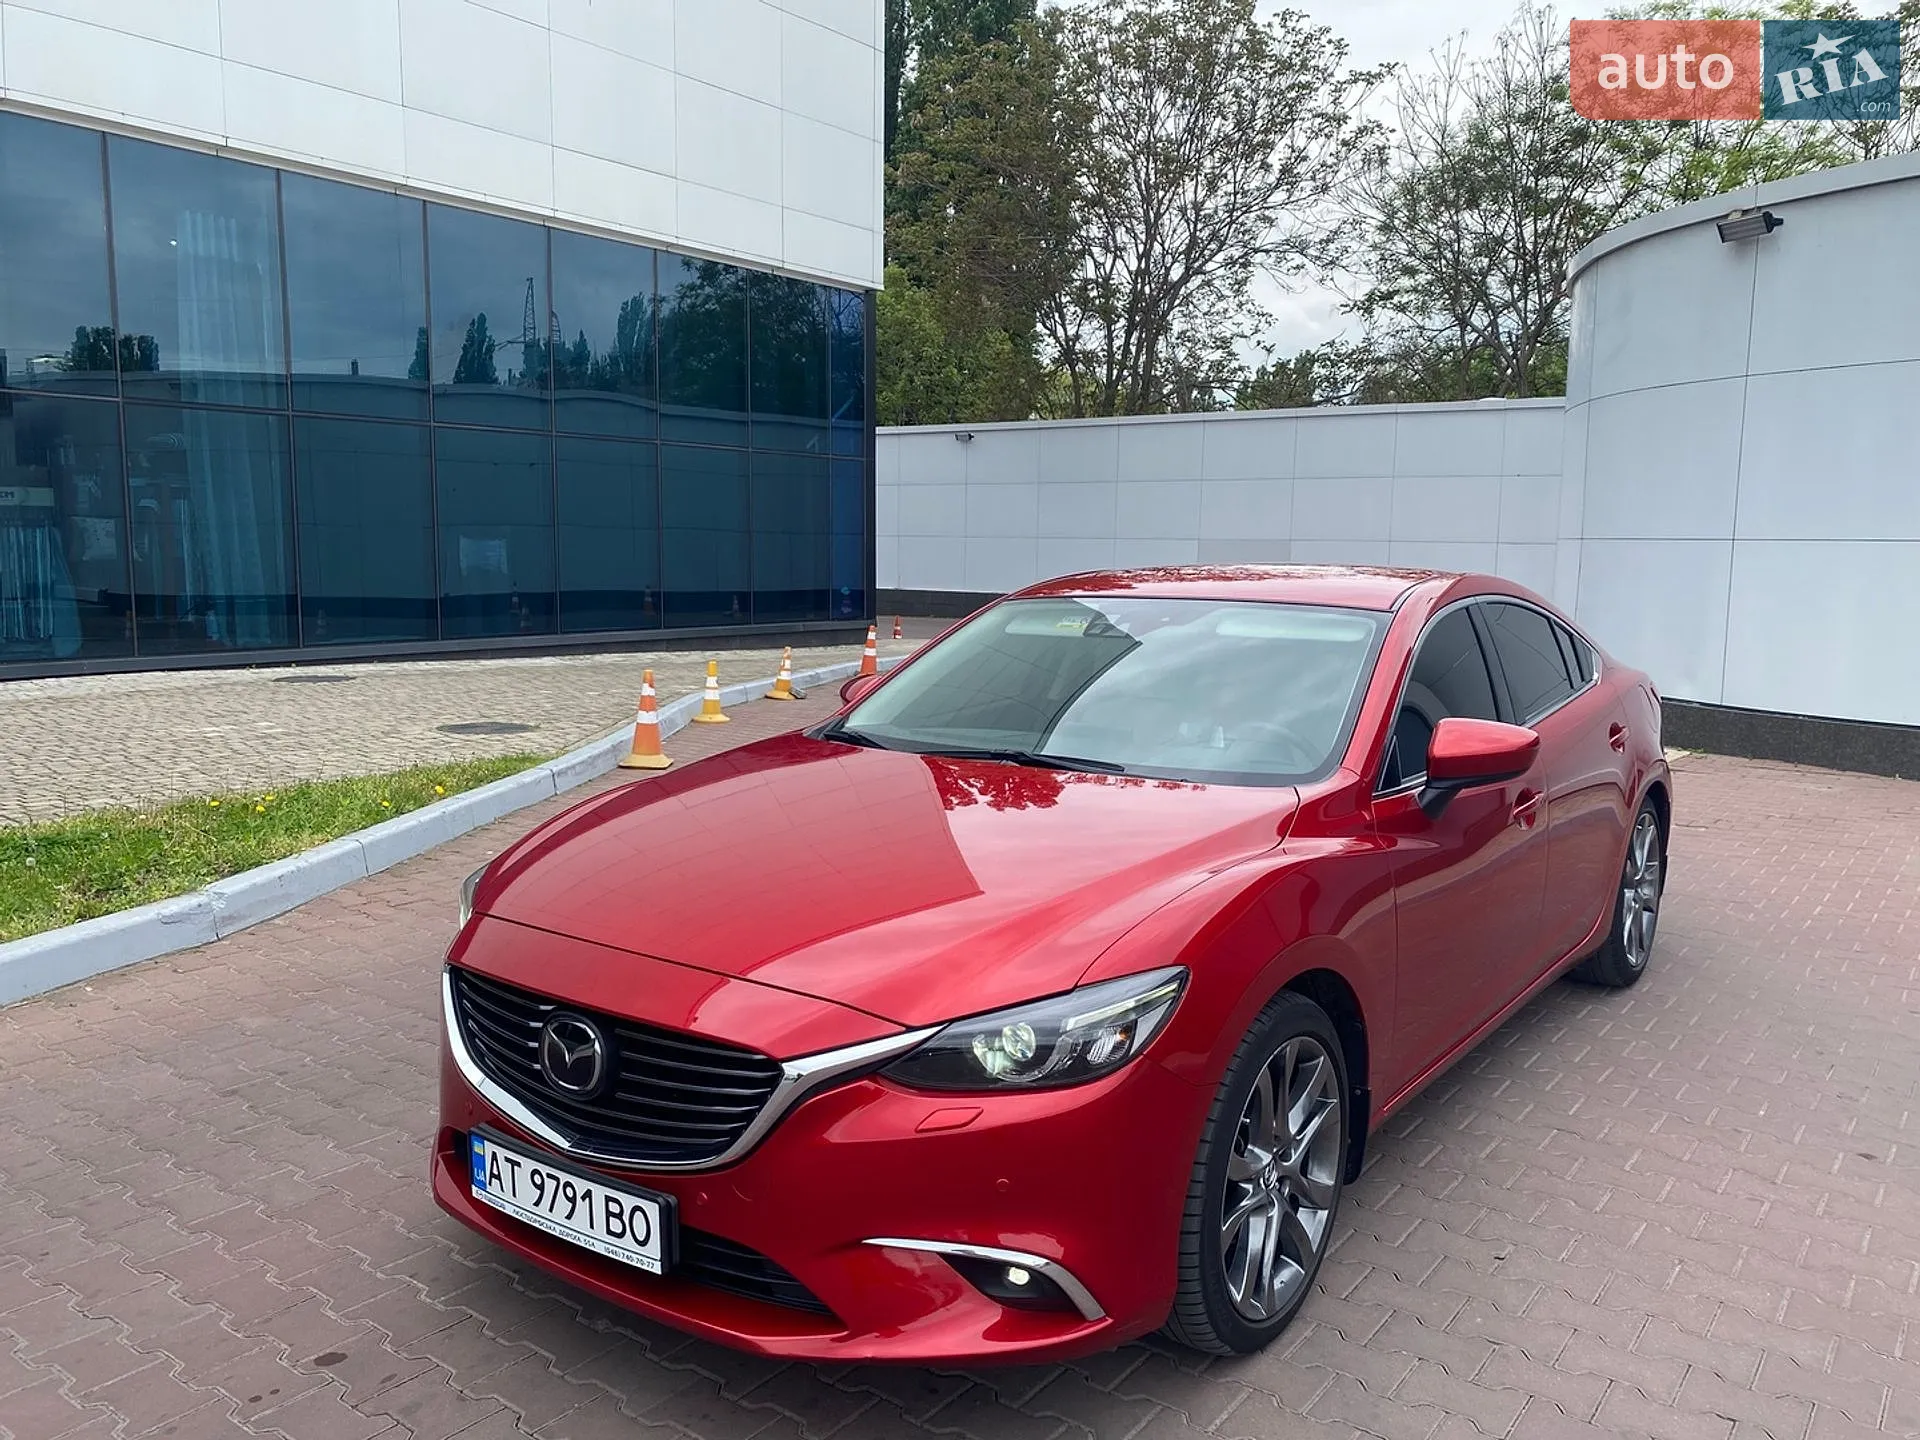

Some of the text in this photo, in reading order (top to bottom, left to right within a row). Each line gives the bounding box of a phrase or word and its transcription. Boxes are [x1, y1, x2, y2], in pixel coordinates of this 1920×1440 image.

[474, 1167, 486, 1182] UA
[488, 1151, 651, 1247] AT 9791 BO
